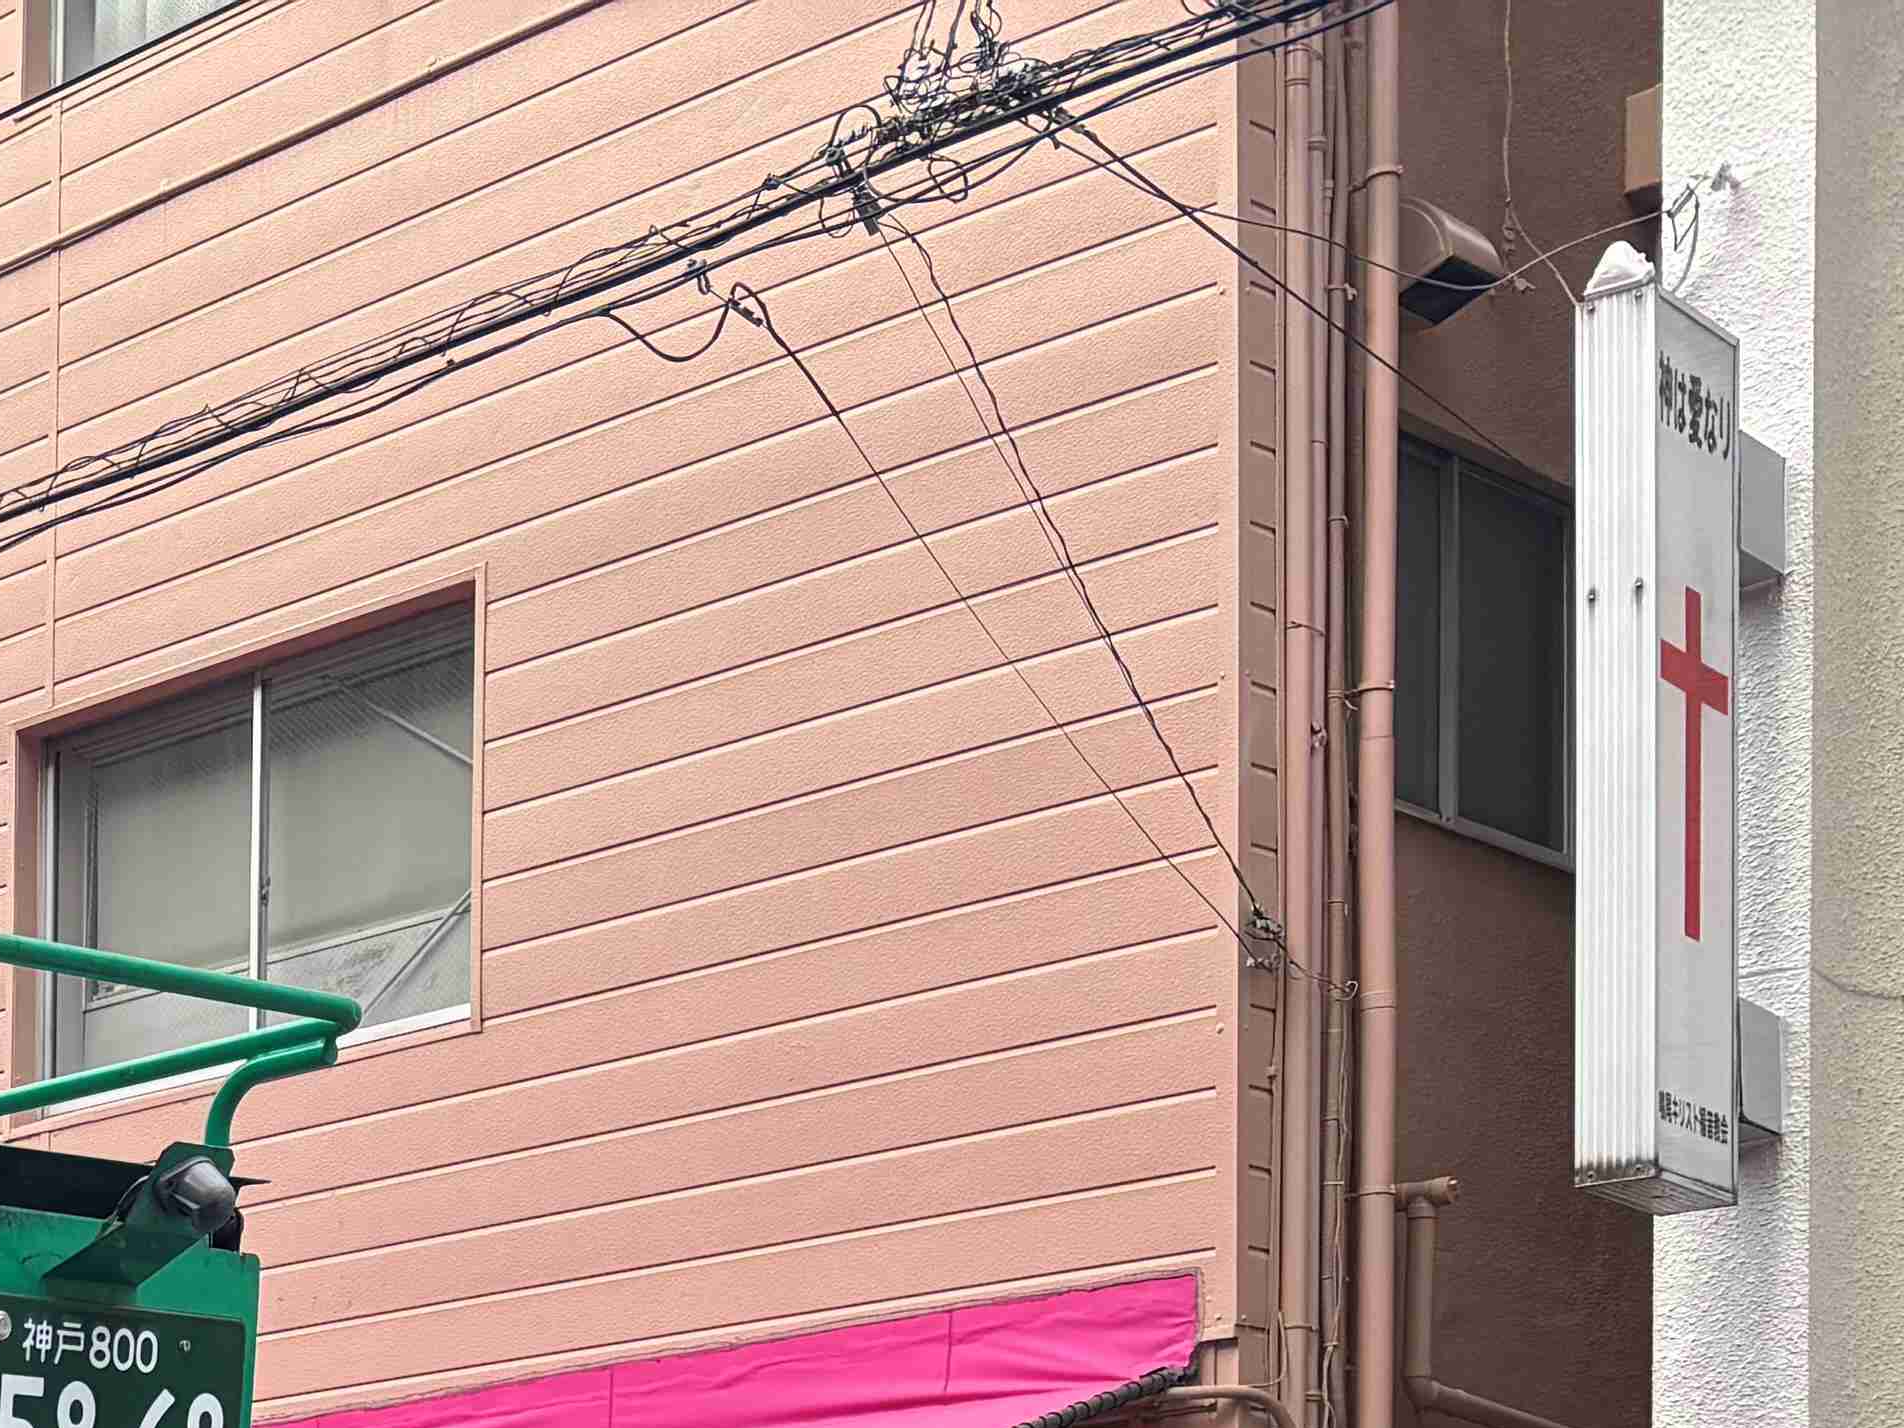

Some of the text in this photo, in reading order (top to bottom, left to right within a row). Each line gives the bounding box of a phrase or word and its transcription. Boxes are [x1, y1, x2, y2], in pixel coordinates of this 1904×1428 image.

[1659, 350, 1732, 460] 神は愛なり
